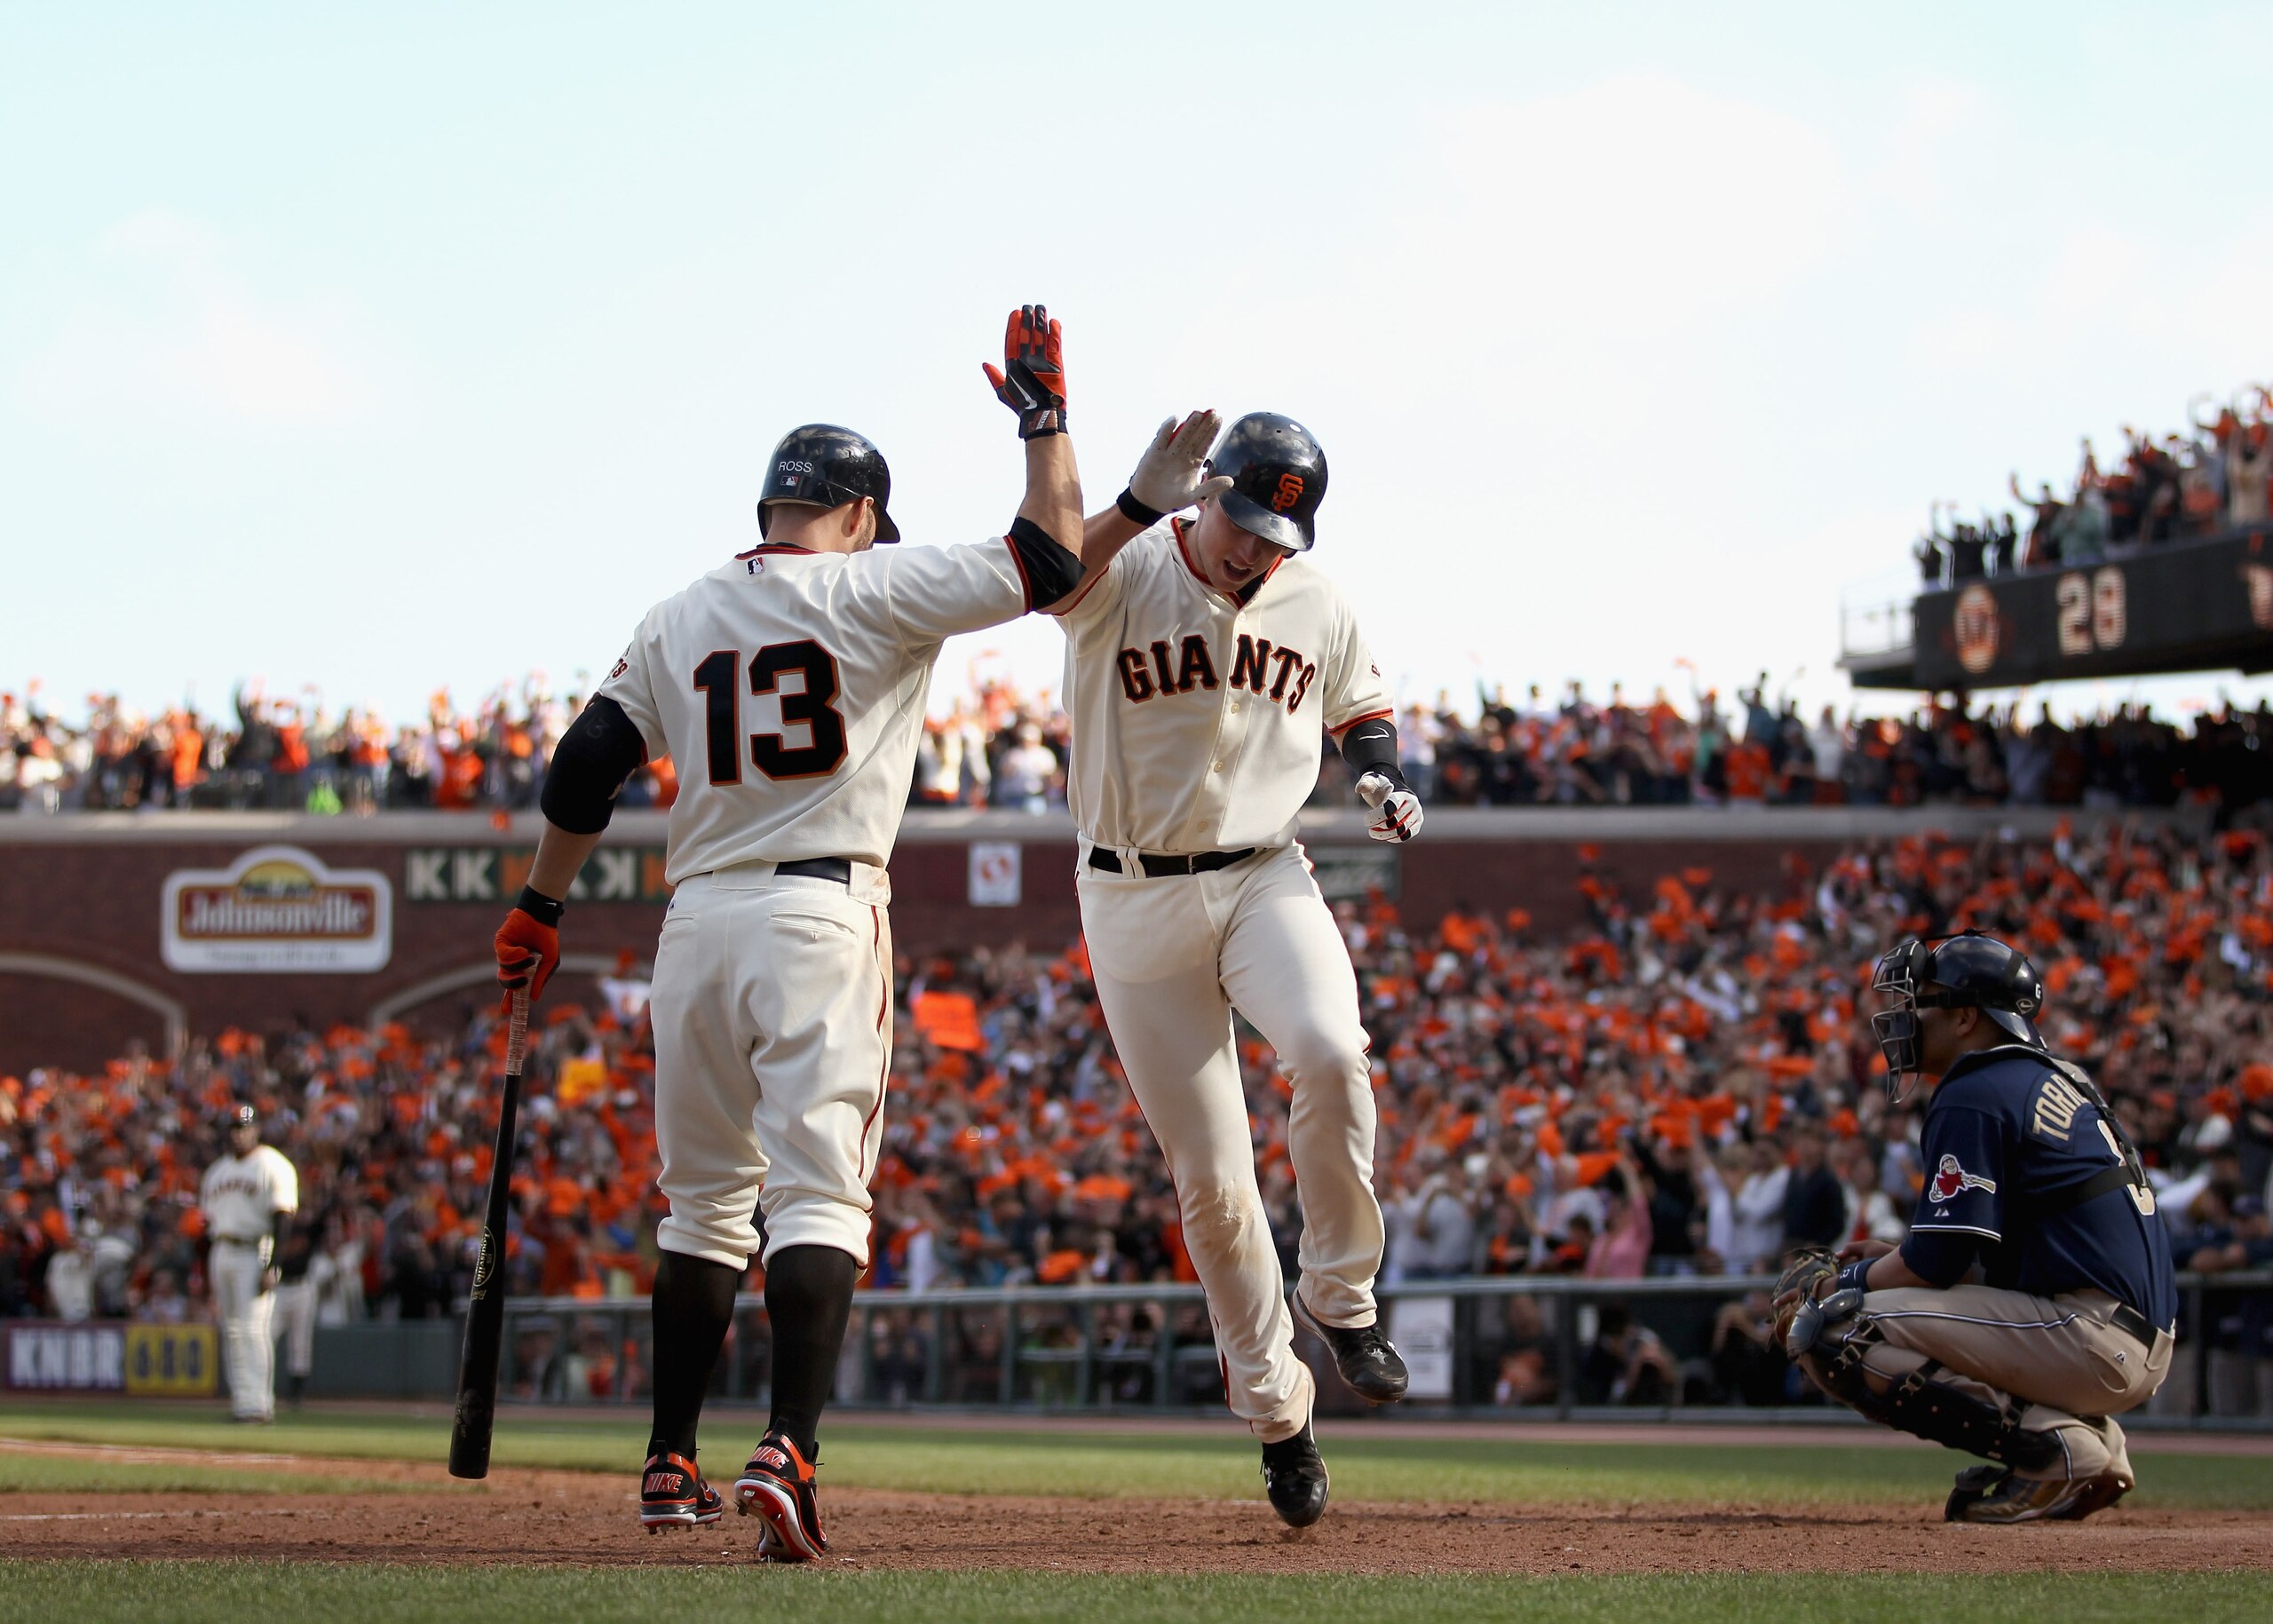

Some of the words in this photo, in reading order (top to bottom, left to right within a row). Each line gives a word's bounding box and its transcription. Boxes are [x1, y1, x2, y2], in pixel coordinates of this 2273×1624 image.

[778, 460, 812, 473] ROSS
[1117, 633, 1316, 716] GIANTS
[693, 638, 849, 787] 13
[11, 1327, 125, 1389] KNBR
[748, 1446, 790, 1470] NIKE
[644, 1472, 684, 1493] NIKE
